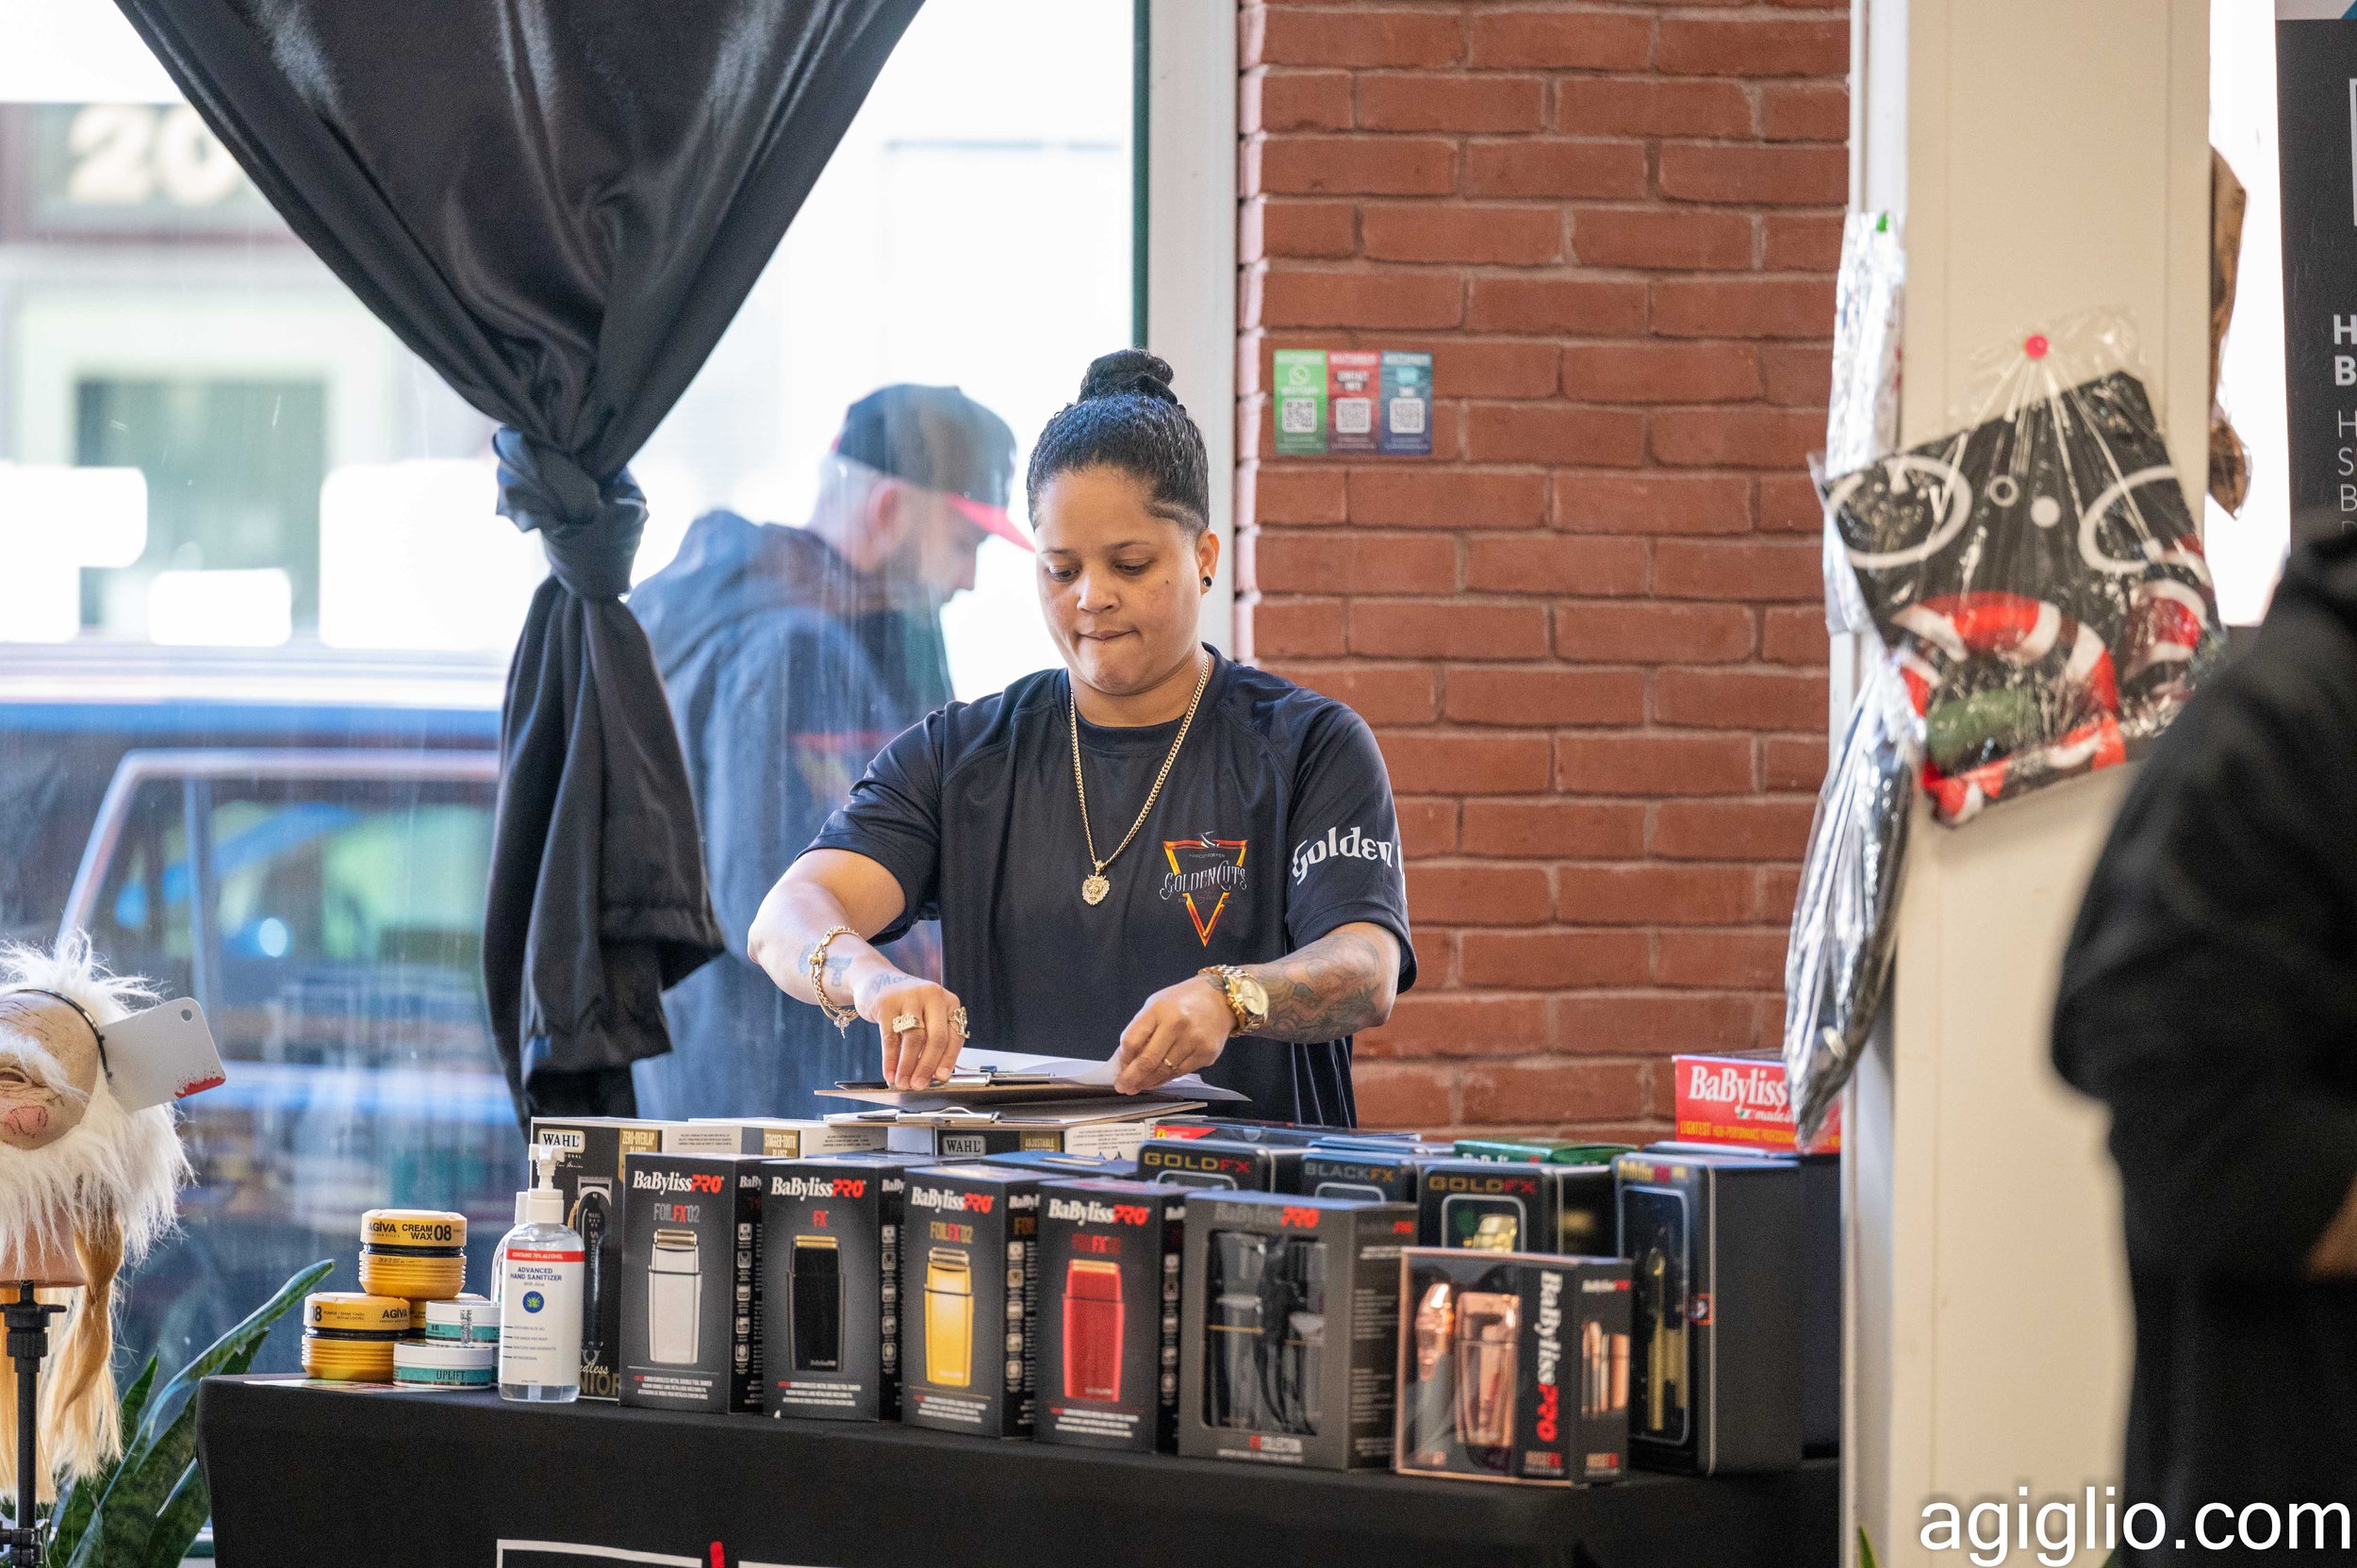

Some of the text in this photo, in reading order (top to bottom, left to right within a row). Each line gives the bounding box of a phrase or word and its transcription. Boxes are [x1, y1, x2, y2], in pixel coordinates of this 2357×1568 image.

[543, 1132, 580, 1147] WAHL
[622, 1131, 655, 1146] ZERO-OVERLAP
[947, 1139, 981, 1153] WAHL
[1025, 1137, 1054, 1148] ADJUSTABLE
[633, 1170, 723, 1196] BaBylissPRO
[770, 1176, 865, 1202] BaBylissPRO
[402, 1223, 433, 1232] CREAM
[410, 1224, 452, 1242] WAX 08
[436, 1370, 466, 1380] UPLIFT
